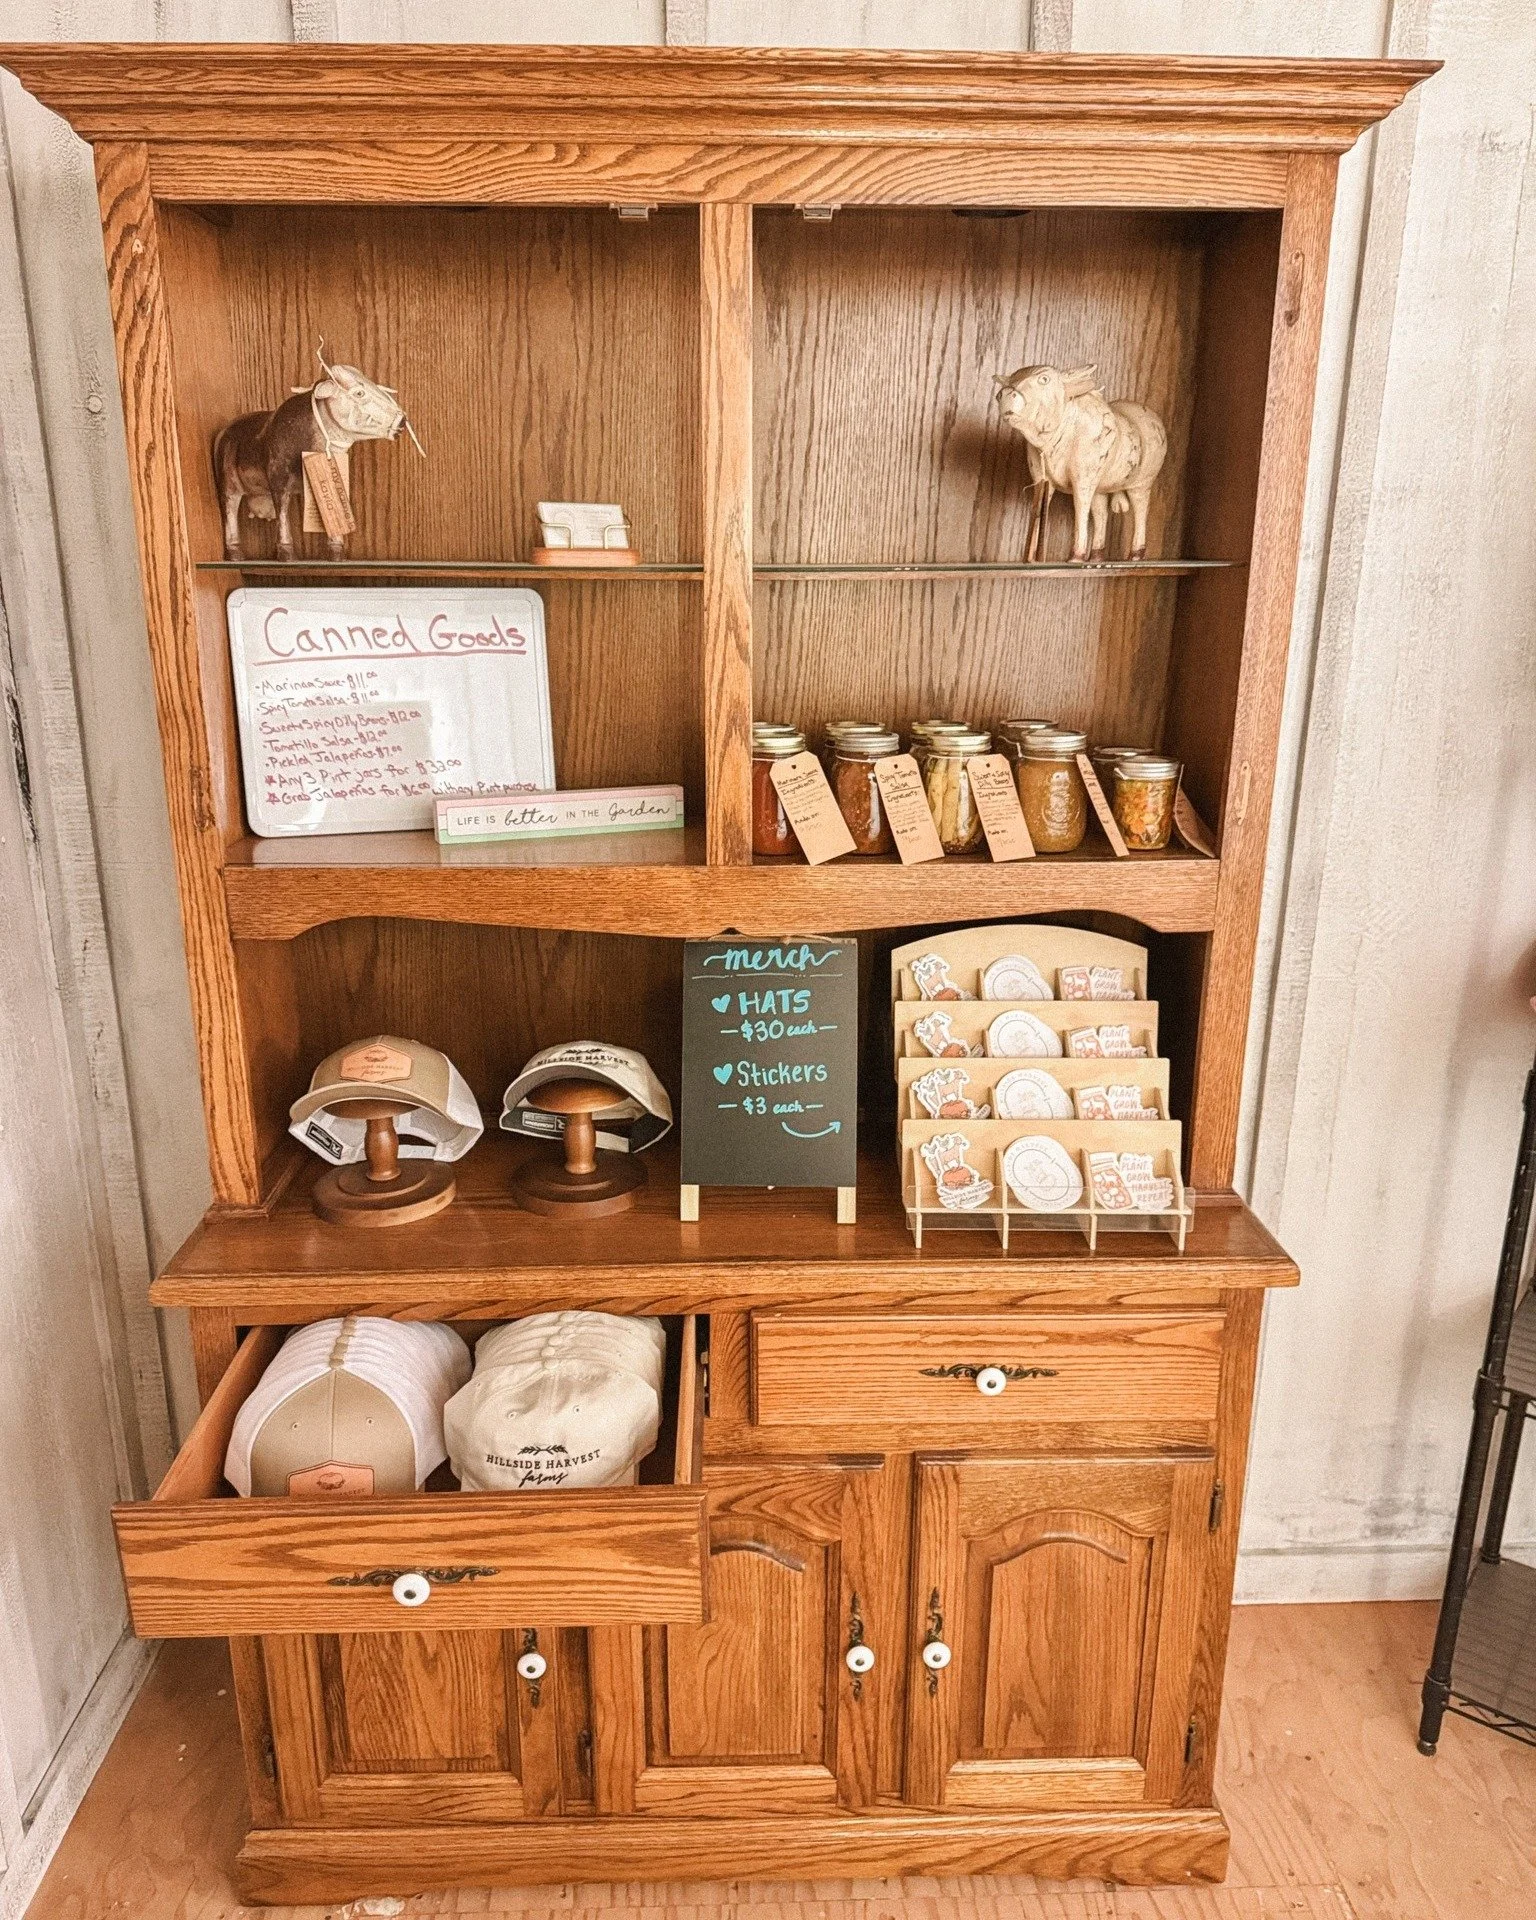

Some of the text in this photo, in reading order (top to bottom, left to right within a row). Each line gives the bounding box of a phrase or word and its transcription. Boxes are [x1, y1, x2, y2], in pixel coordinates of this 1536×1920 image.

[264, 607, 526, 657] Canned Goods
[264, 739, 319, 753] Tomatillo
[268, 754, 314, 769] Pickled
[278, 773, 305, 792] Any
[319, 769, 352, 783] Pint
[385, 765, 410, 777] for
[380, 784, 400, 797] for
[477, 780, 501, 794] Pint
[457, 816, 480, 826] LIFE
[486, 815, 496, 824] IS
[504, 809, 558, 826] better
[582, 809, 599, 818] THE
[608, 801, 671, 821] Garden
[714, 944, 832, 971] merch
[737, 988, 811, 1015] HATS
[741, 1019, 818, 1042] $30 each
[537, 1054, 629, 1066] HILLSIDE HARVEST
[737, 1061, 828, 1087] Stickers
[742, 1096, 805, 1115] $3 each
[486, 1449, 601, 1469] HILLSIDE HARVEST
[518, 1469, 569, 1488] farms
